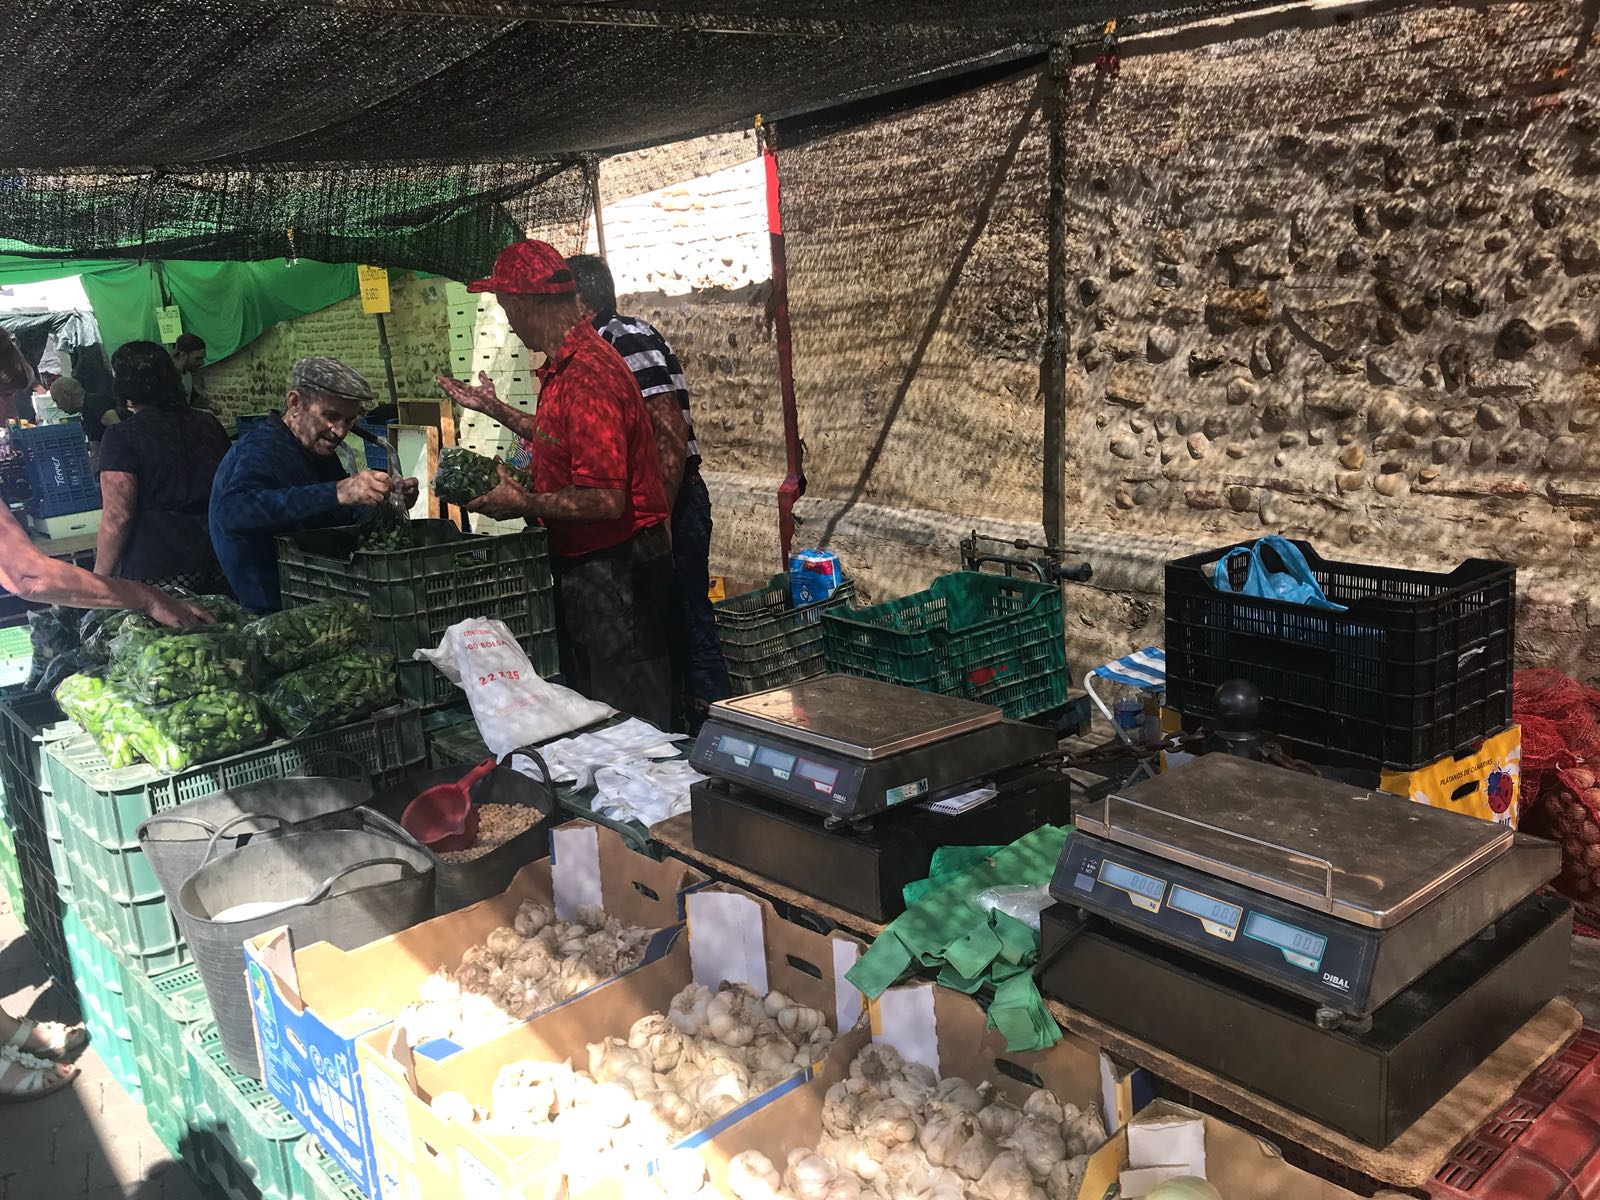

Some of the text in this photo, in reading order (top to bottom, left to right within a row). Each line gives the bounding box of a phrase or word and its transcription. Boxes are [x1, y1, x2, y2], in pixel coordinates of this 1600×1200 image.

[1440, 771, 1464, 787] PLÁTANOS
[1464, 768, 1471, 777] DE
[832, 792, 847, 802] DIBAL
[1322, 972, 1350, 989] DIBAL
